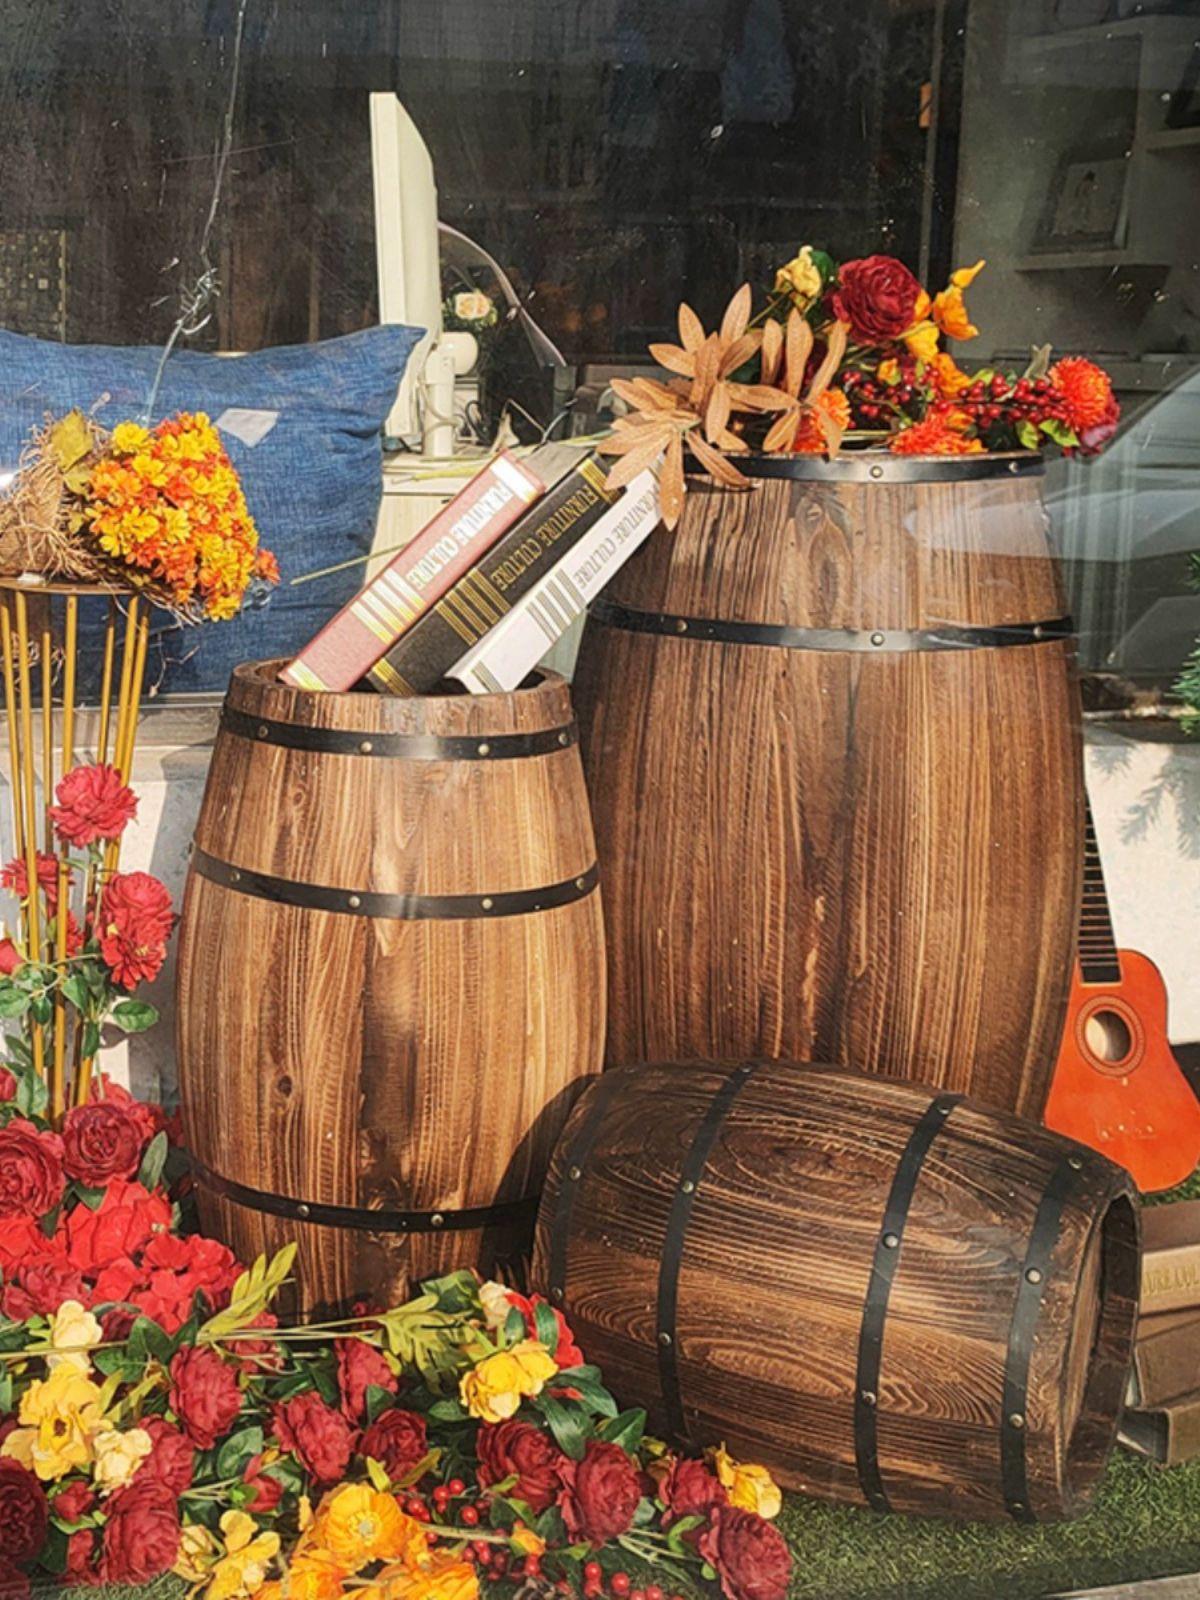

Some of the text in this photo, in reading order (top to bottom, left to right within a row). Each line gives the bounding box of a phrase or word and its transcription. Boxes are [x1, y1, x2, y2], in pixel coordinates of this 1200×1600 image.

[405, 482, 514, 590] FURNITURE CULTURE
[491, 485, 600, 591] FURNITURE CULTURE
[573, 537, 616, 589] CULTURE
